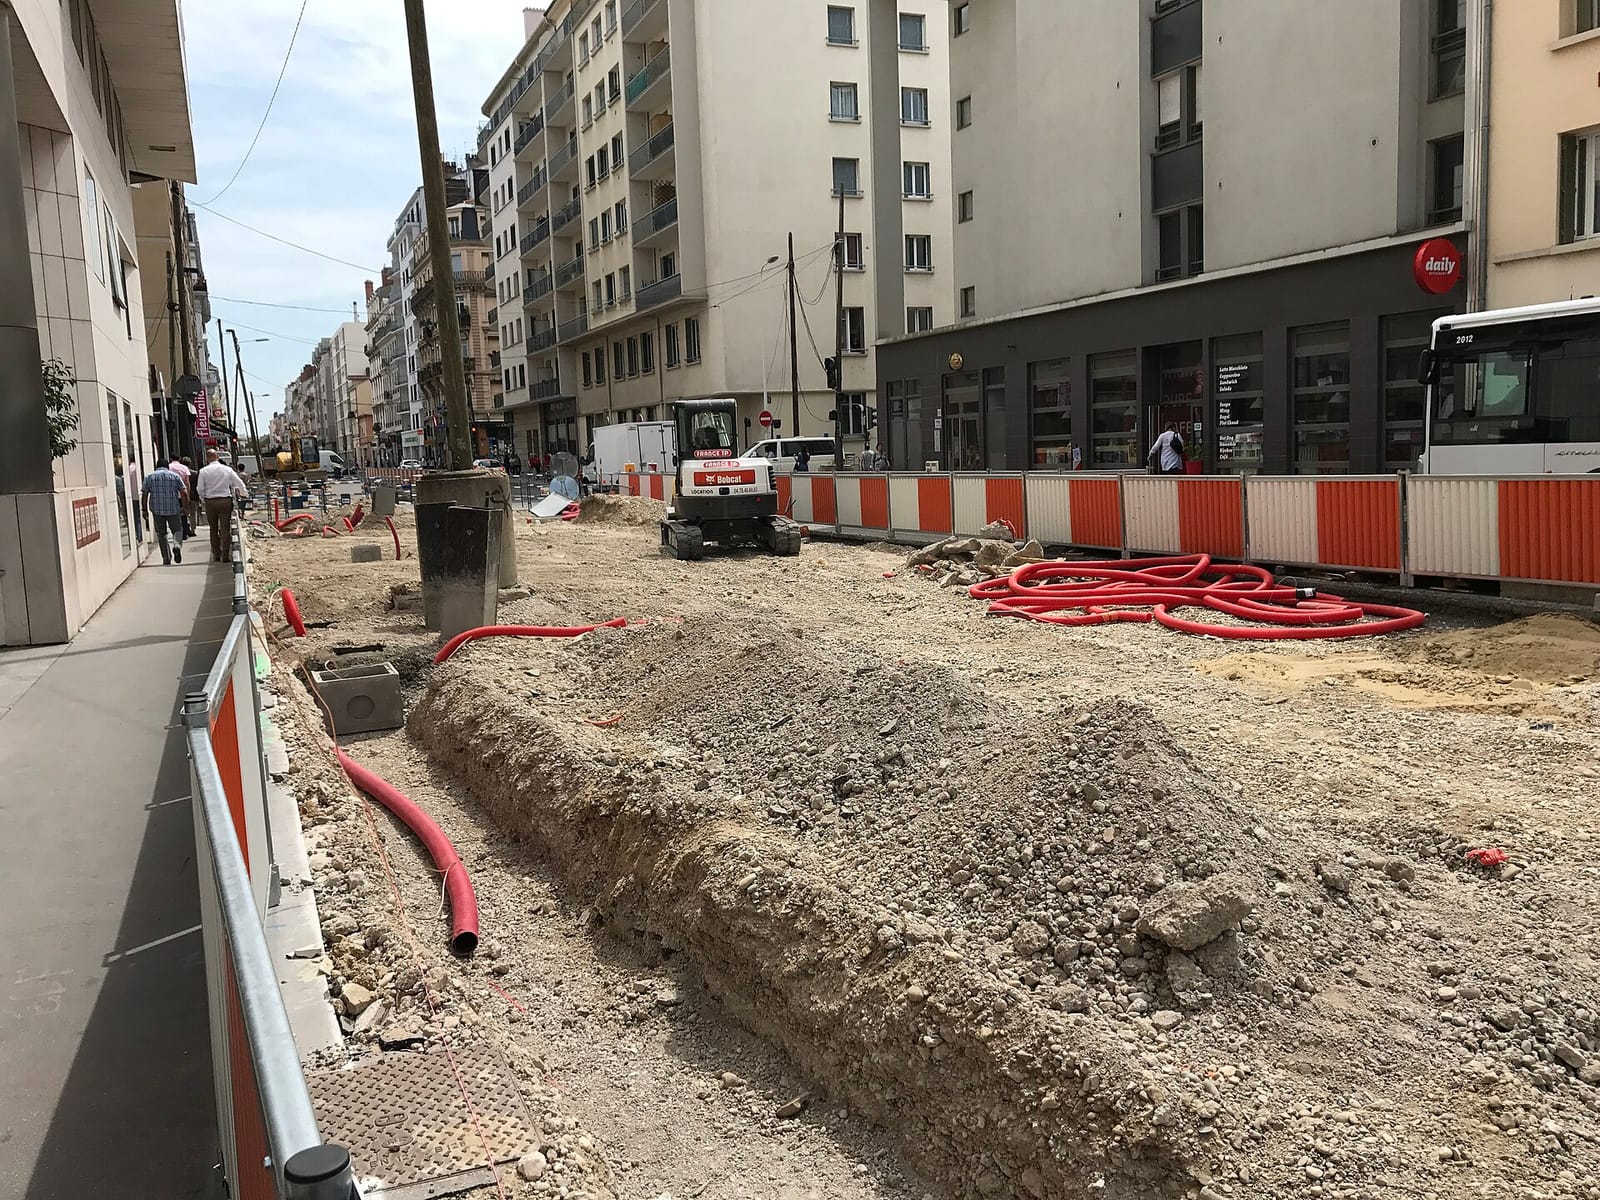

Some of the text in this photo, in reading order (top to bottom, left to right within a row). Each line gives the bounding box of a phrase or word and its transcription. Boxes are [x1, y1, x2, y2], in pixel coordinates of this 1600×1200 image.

[1425, 256, 1456, 275] daily
[1456, 334, 1474, 344] 2012
[717, 474, 742, 484] Bobcat
